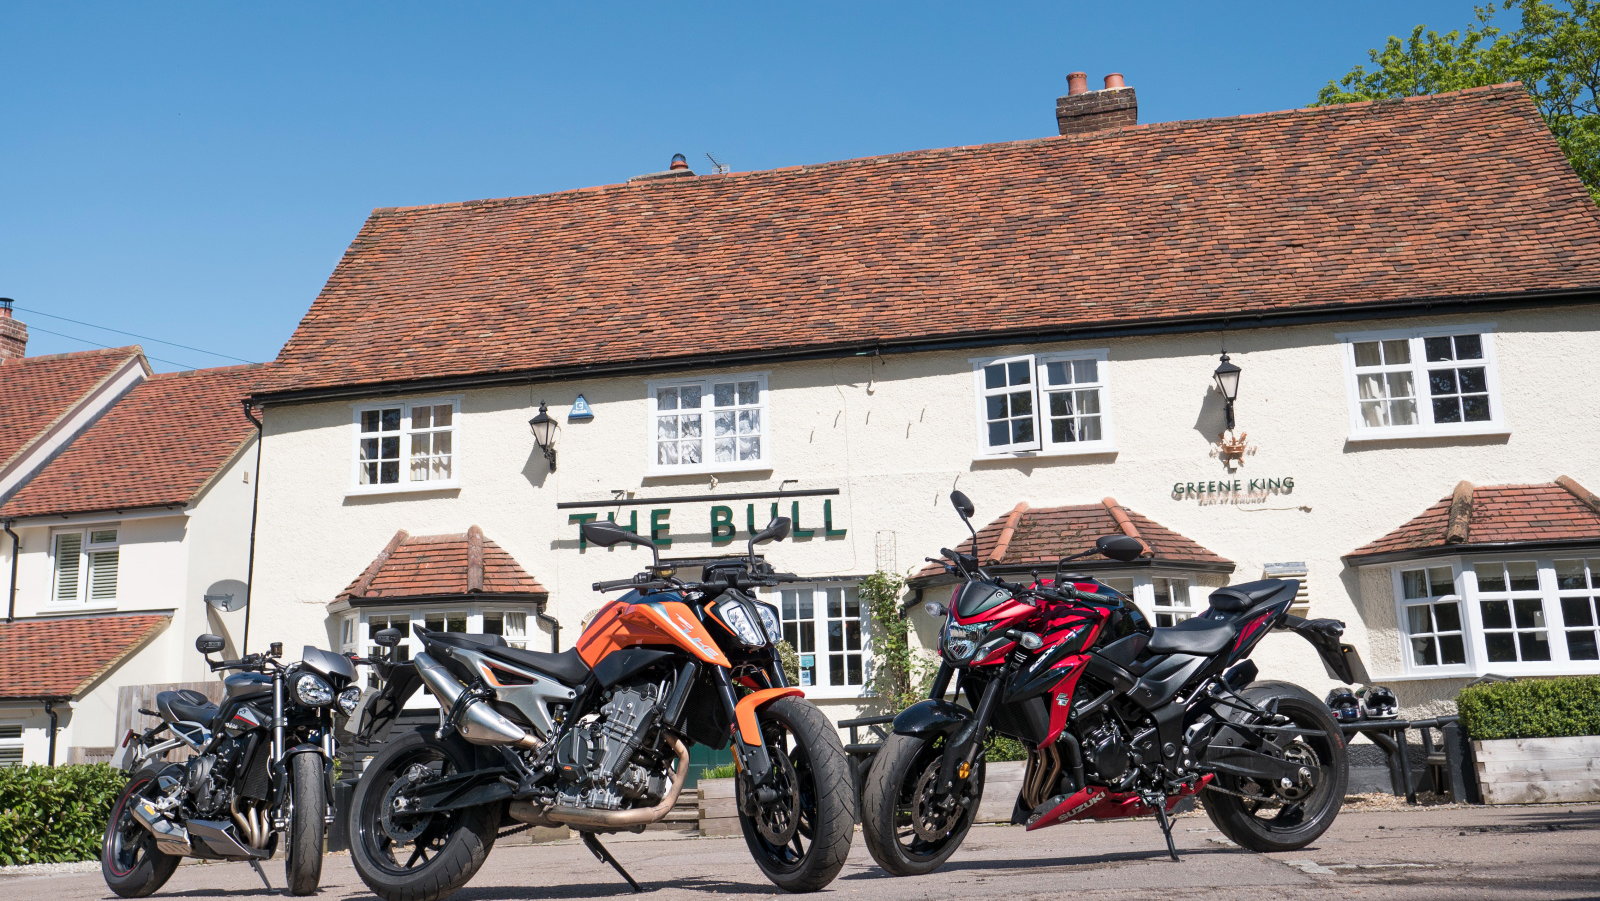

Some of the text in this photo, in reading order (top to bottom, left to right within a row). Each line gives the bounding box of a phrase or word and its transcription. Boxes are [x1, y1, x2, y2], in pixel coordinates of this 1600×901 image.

[1173, 476, 1295, 494] GREENE KING
[568, 499, 847, 549] THE BULL
[1057, 791, 1106, 821] SUZUKI
